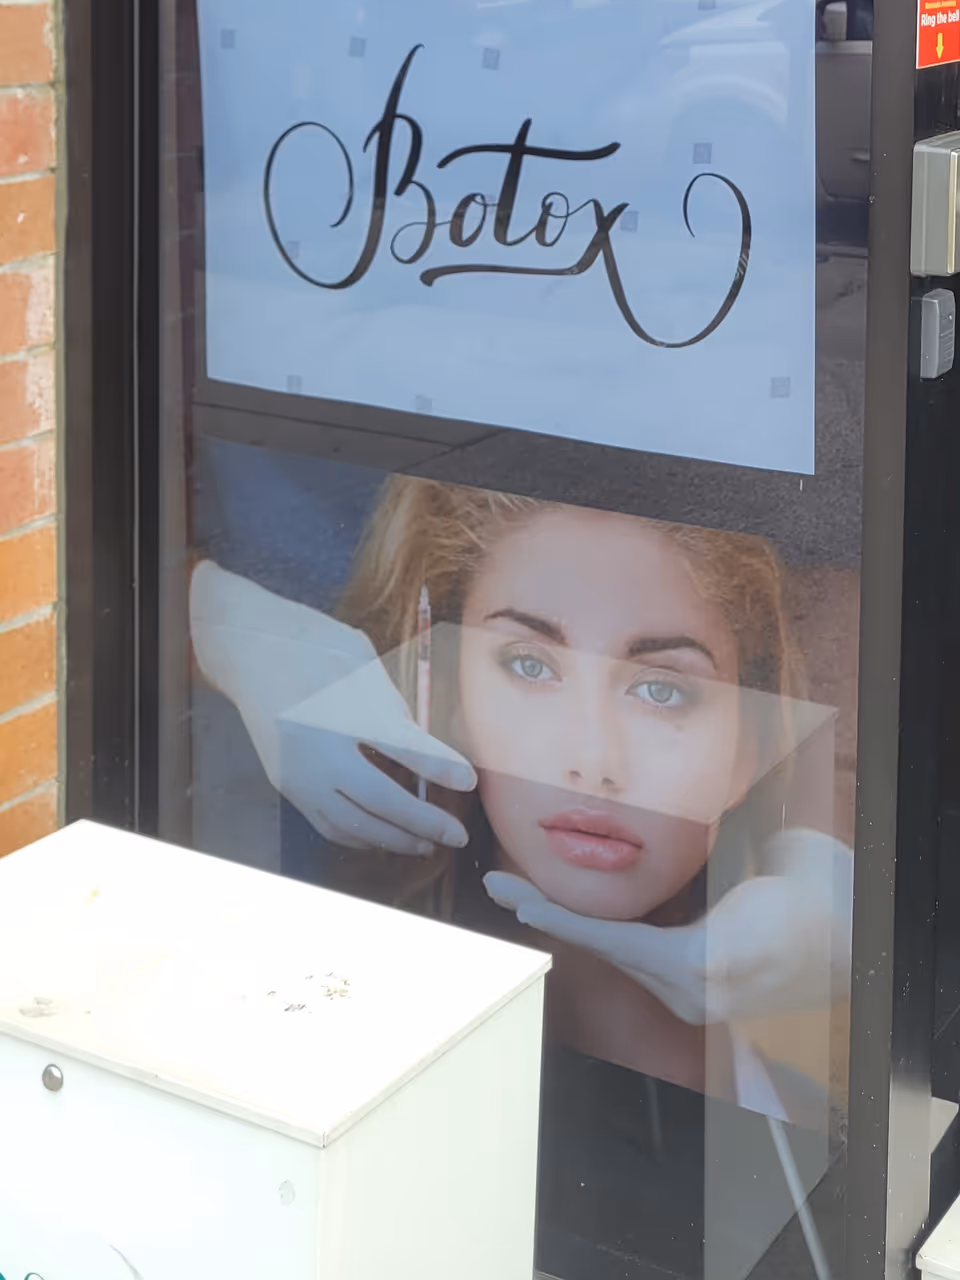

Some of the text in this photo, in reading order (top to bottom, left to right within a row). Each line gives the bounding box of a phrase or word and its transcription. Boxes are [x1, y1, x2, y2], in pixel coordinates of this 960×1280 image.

[921, 9, 960, 27] Ring the bell
[263, 43, 752, 348] Botox
